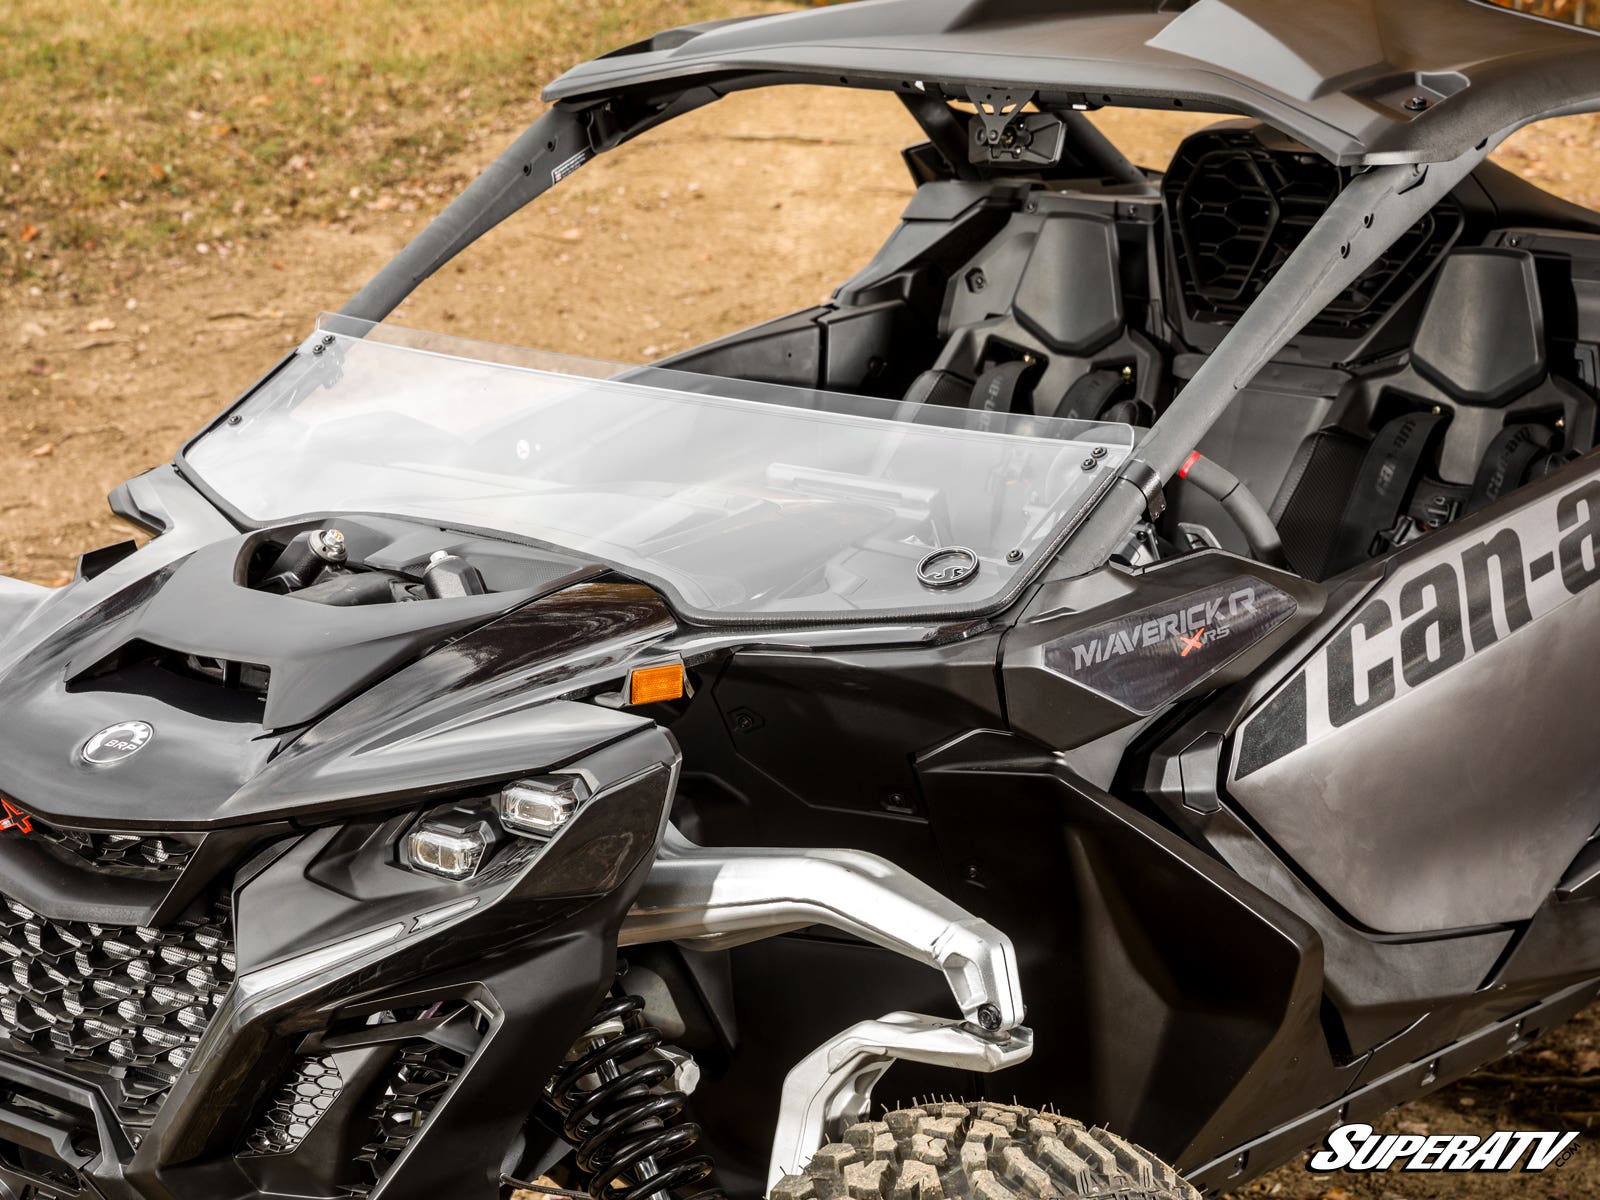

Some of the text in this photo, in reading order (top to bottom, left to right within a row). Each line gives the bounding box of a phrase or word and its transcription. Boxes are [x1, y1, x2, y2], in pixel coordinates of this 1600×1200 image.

[1072, 587, 1257, 670] MAVERICK R
[105, 738, 138, 752] BRP
